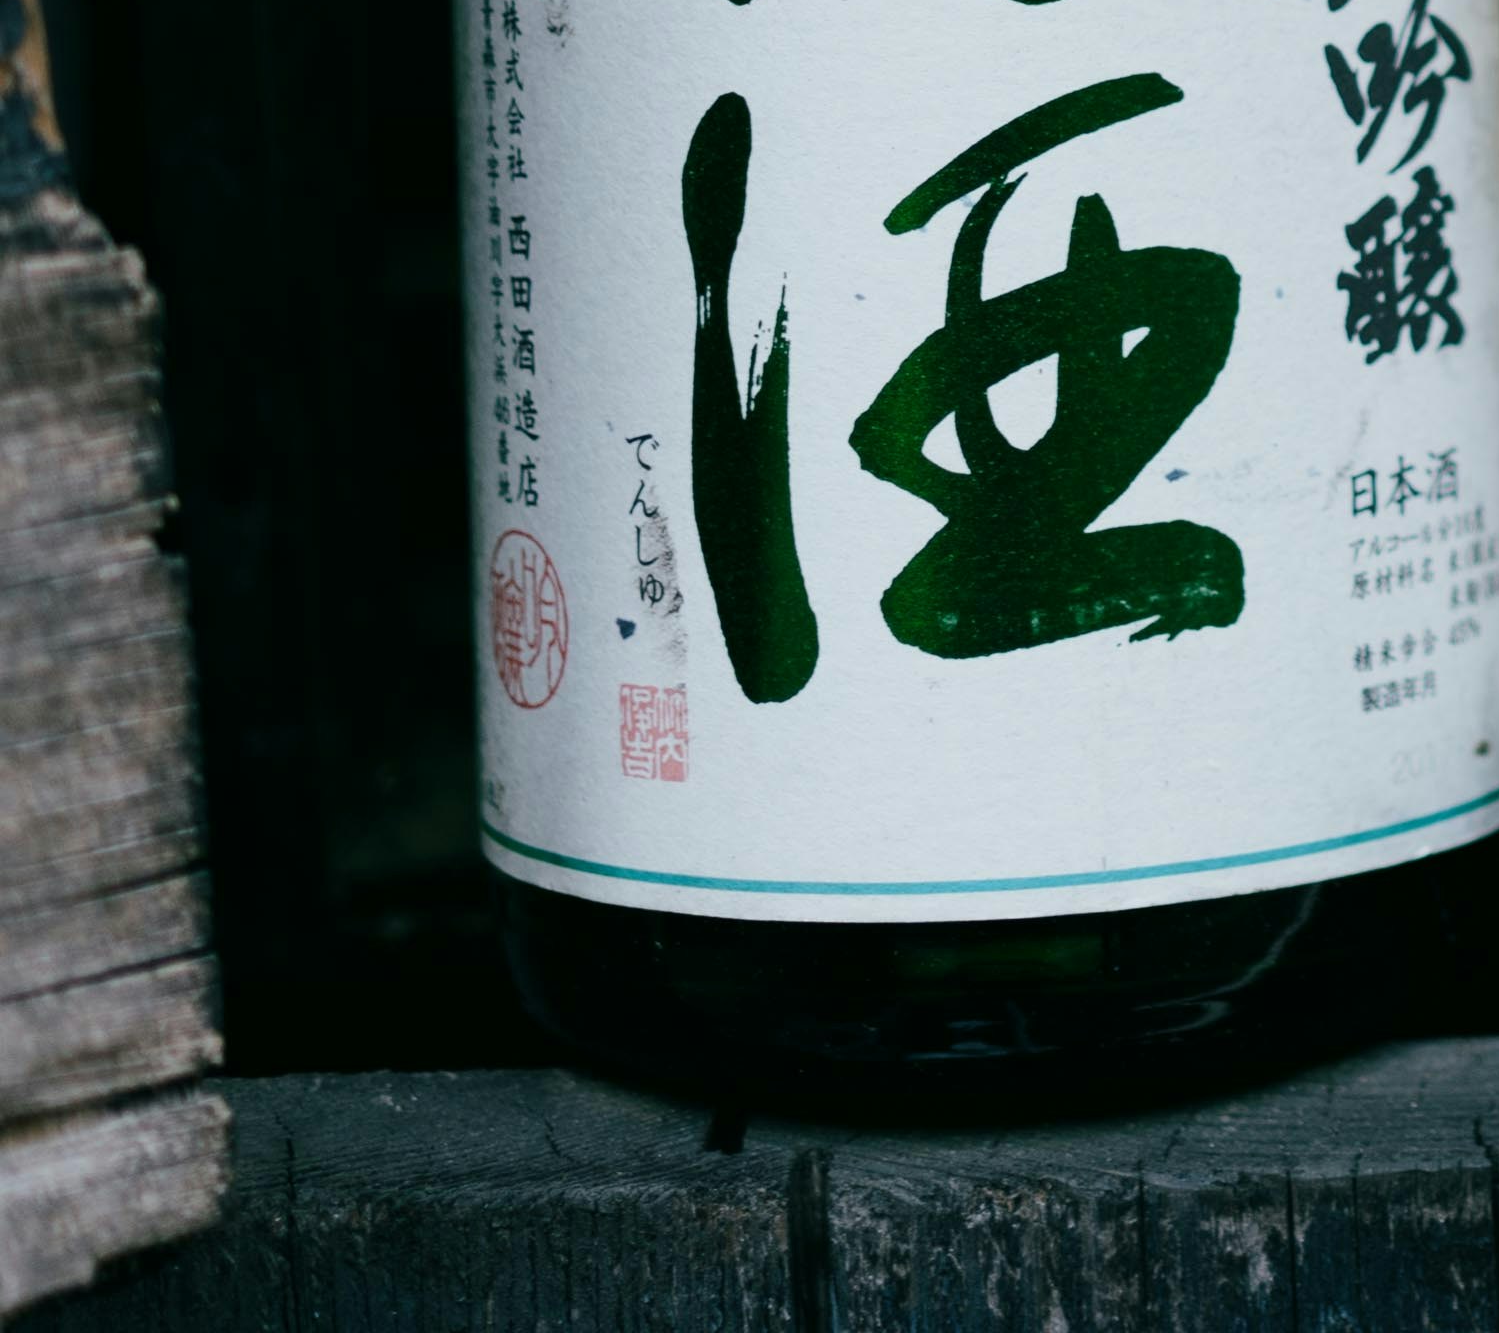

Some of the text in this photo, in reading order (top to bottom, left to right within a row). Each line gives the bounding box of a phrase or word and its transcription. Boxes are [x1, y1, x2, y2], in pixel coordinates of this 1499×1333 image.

[503, 0, 528, 182] 株式会社
[506, 214, 541, 507] 西田酒造店
[625, 433, 666, 609] でんしゅ
[1351, 447, 1458, 517] 日本酒
